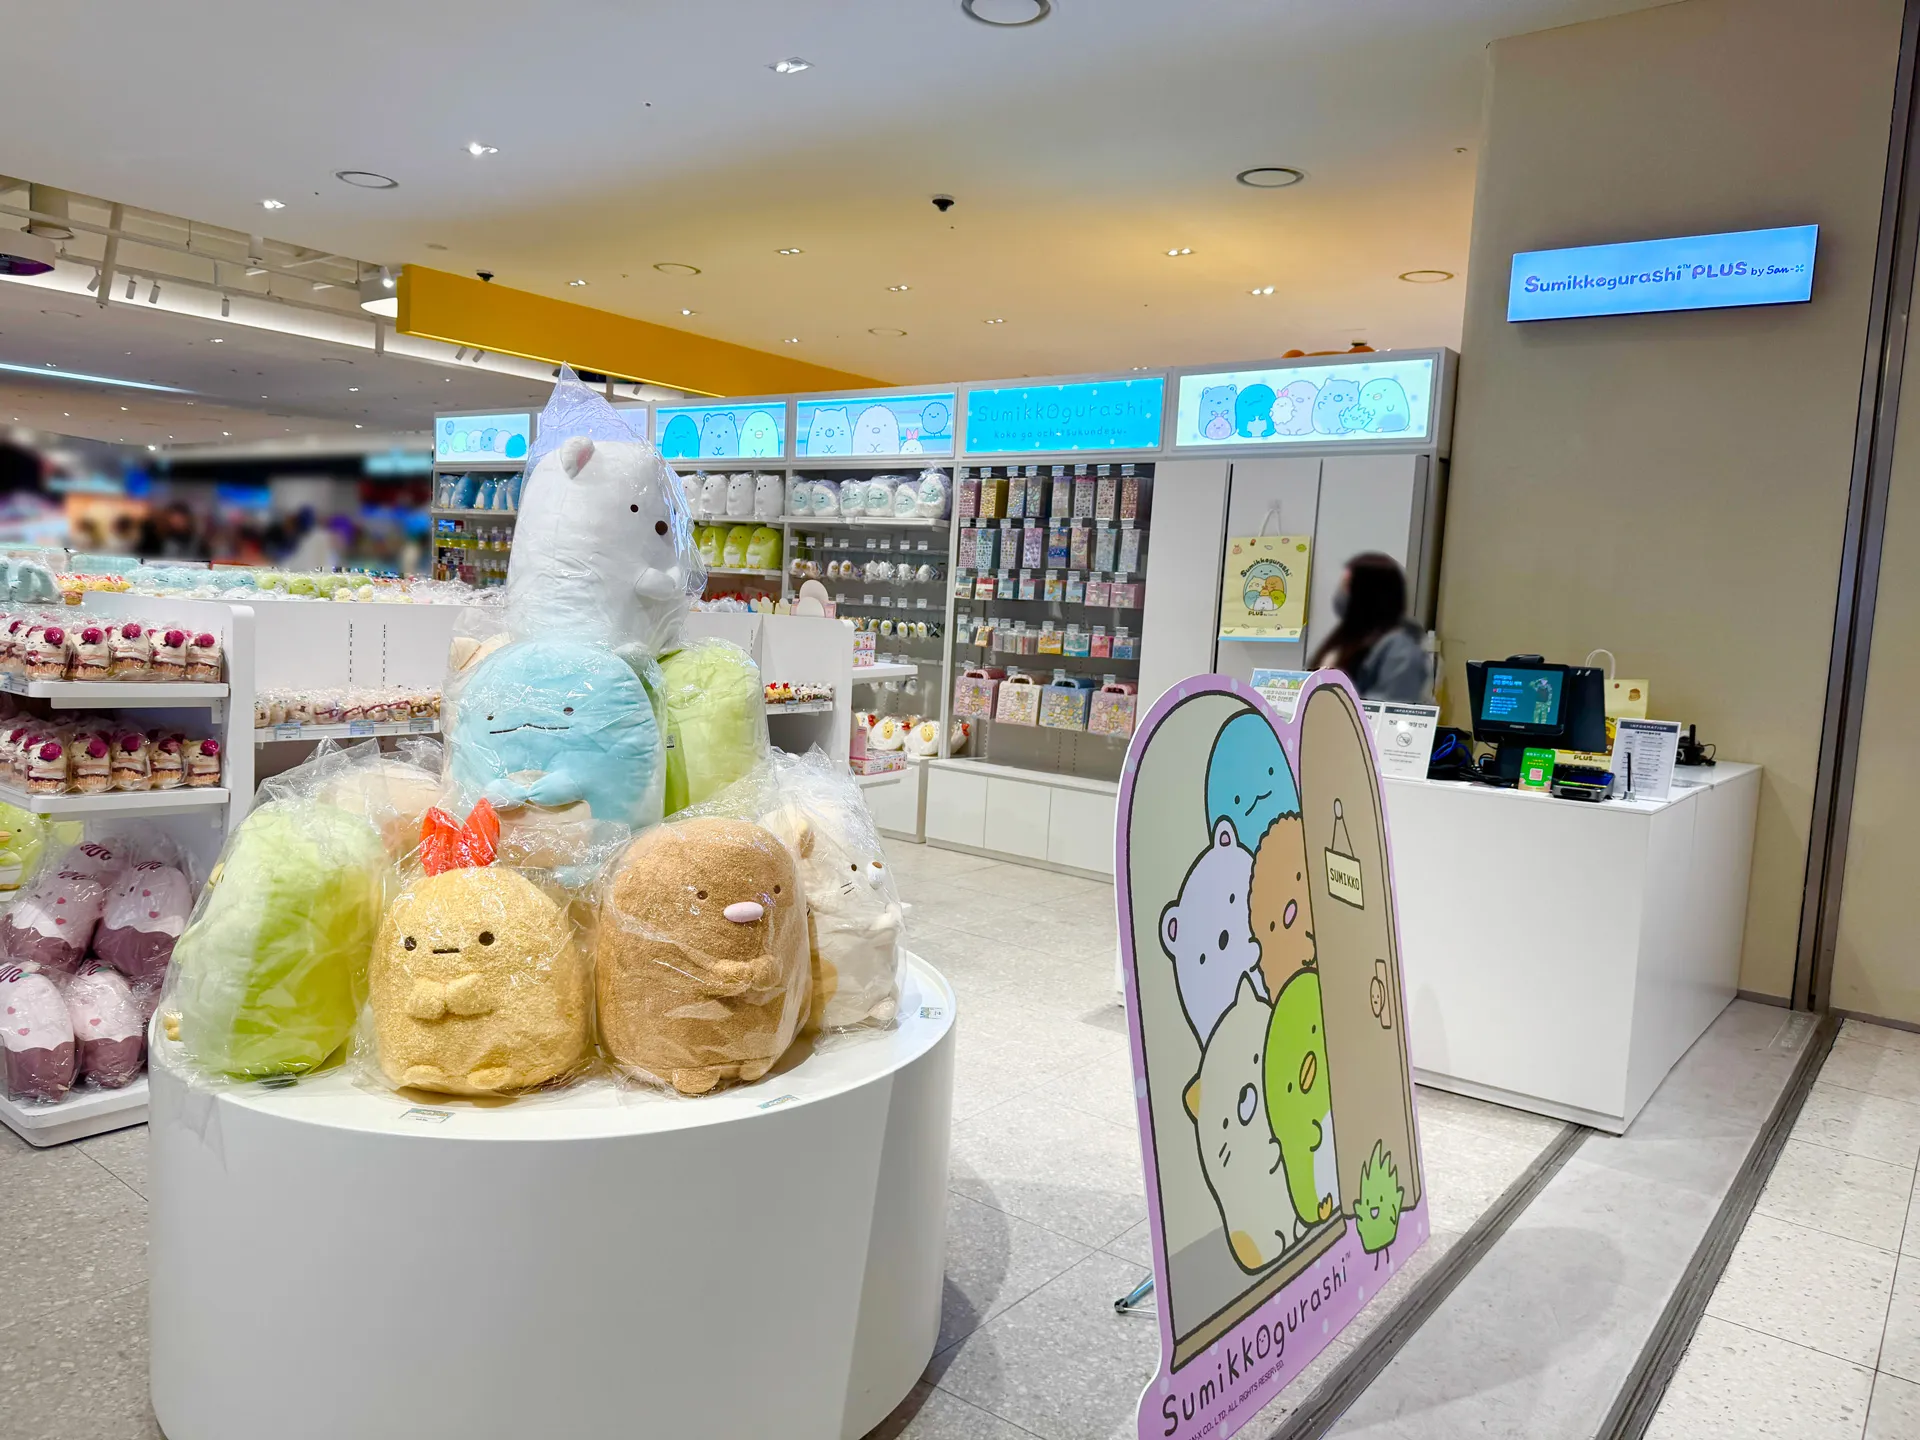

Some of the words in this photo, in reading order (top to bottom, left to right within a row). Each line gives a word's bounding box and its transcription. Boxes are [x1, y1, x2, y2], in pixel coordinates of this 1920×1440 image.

[1692, 260, 1748, 279] PLUS
[1750, 267, 1765, 277] by
[1573, 754, 1593, 762] PLUS
[1329, 867, 1360, 891] SUMIKKO
[1227, 1399, 1239, 1414] ALL
[1238, 1382, 1259, 1405] RIGHTS
